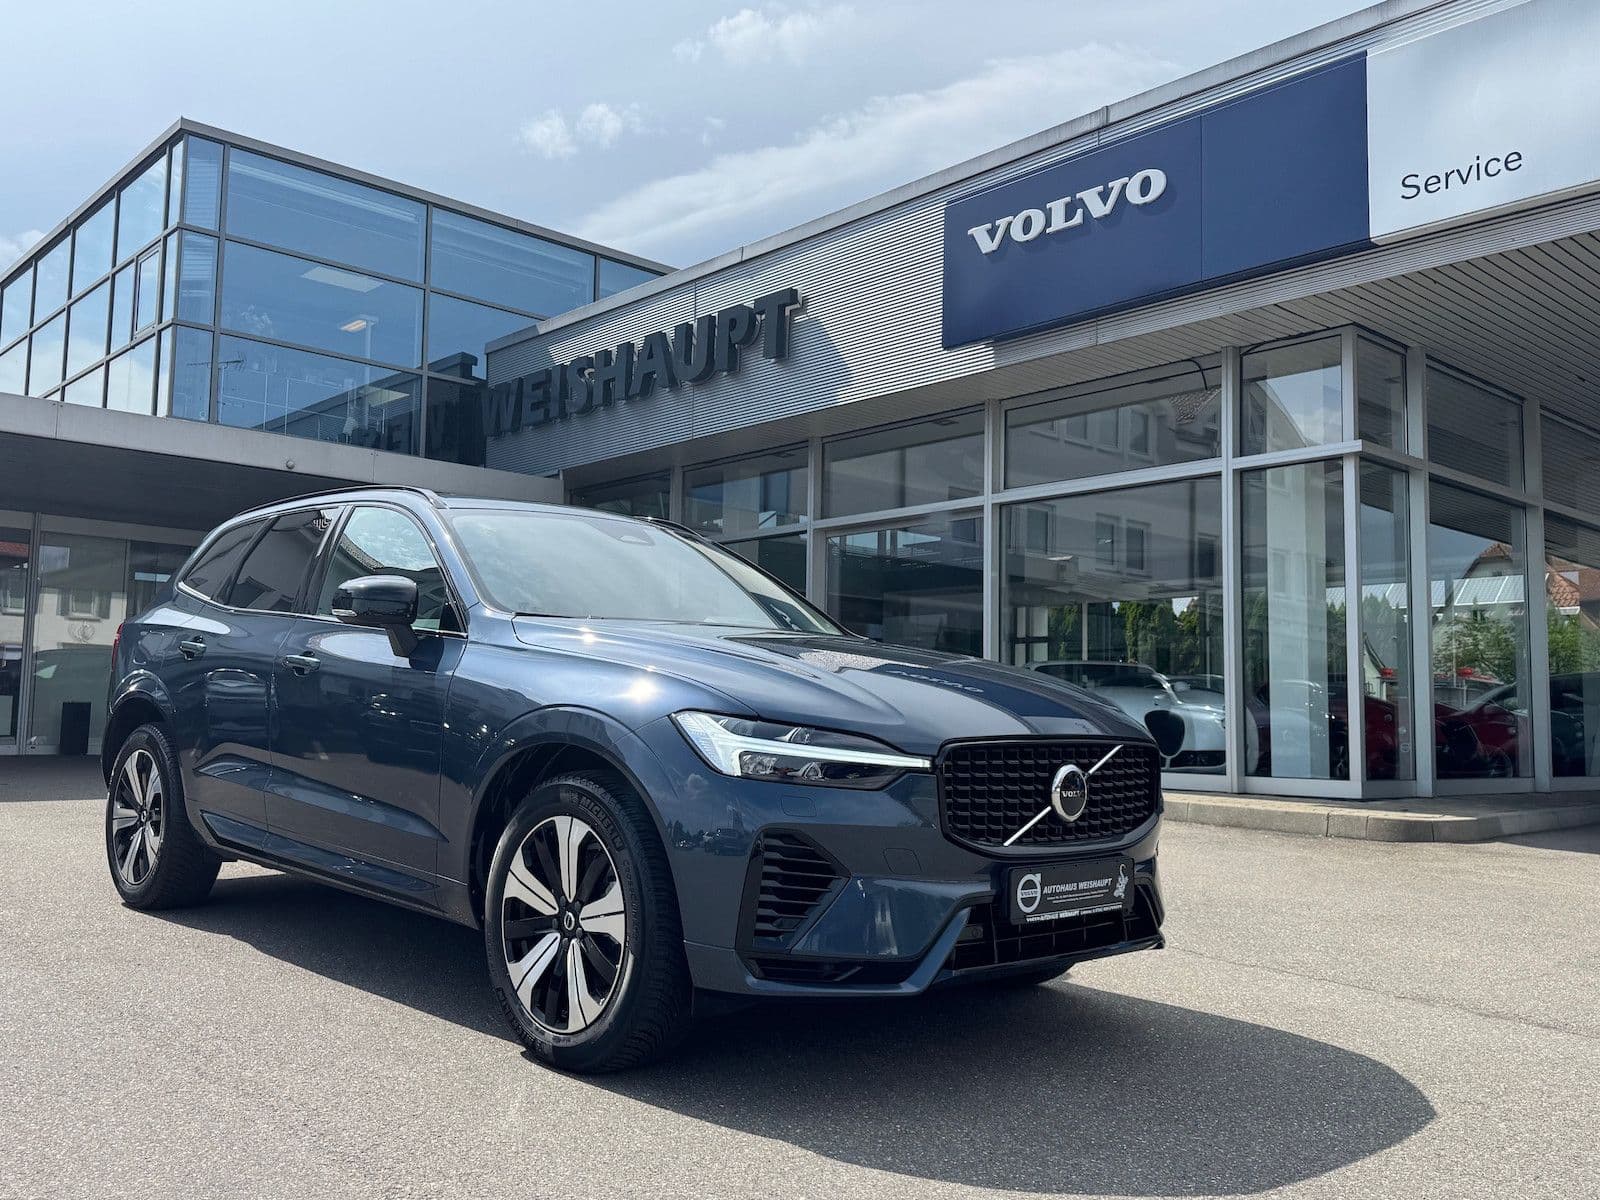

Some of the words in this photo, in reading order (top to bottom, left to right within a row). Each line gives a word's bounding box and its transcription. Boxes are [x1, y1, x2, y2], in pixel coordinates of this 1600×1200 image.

[1401, 151, 1523, 200] Service
[967, 168, 1167, 254] VOLVO
[482, 287, 802, 437] WEISHAUPT
[1061, 790, 1083, 798] VOLV
[1043, 883, 1078, 894] AUTOHAUS
[1078, 877, 1113, 890] WEISHAUPT
